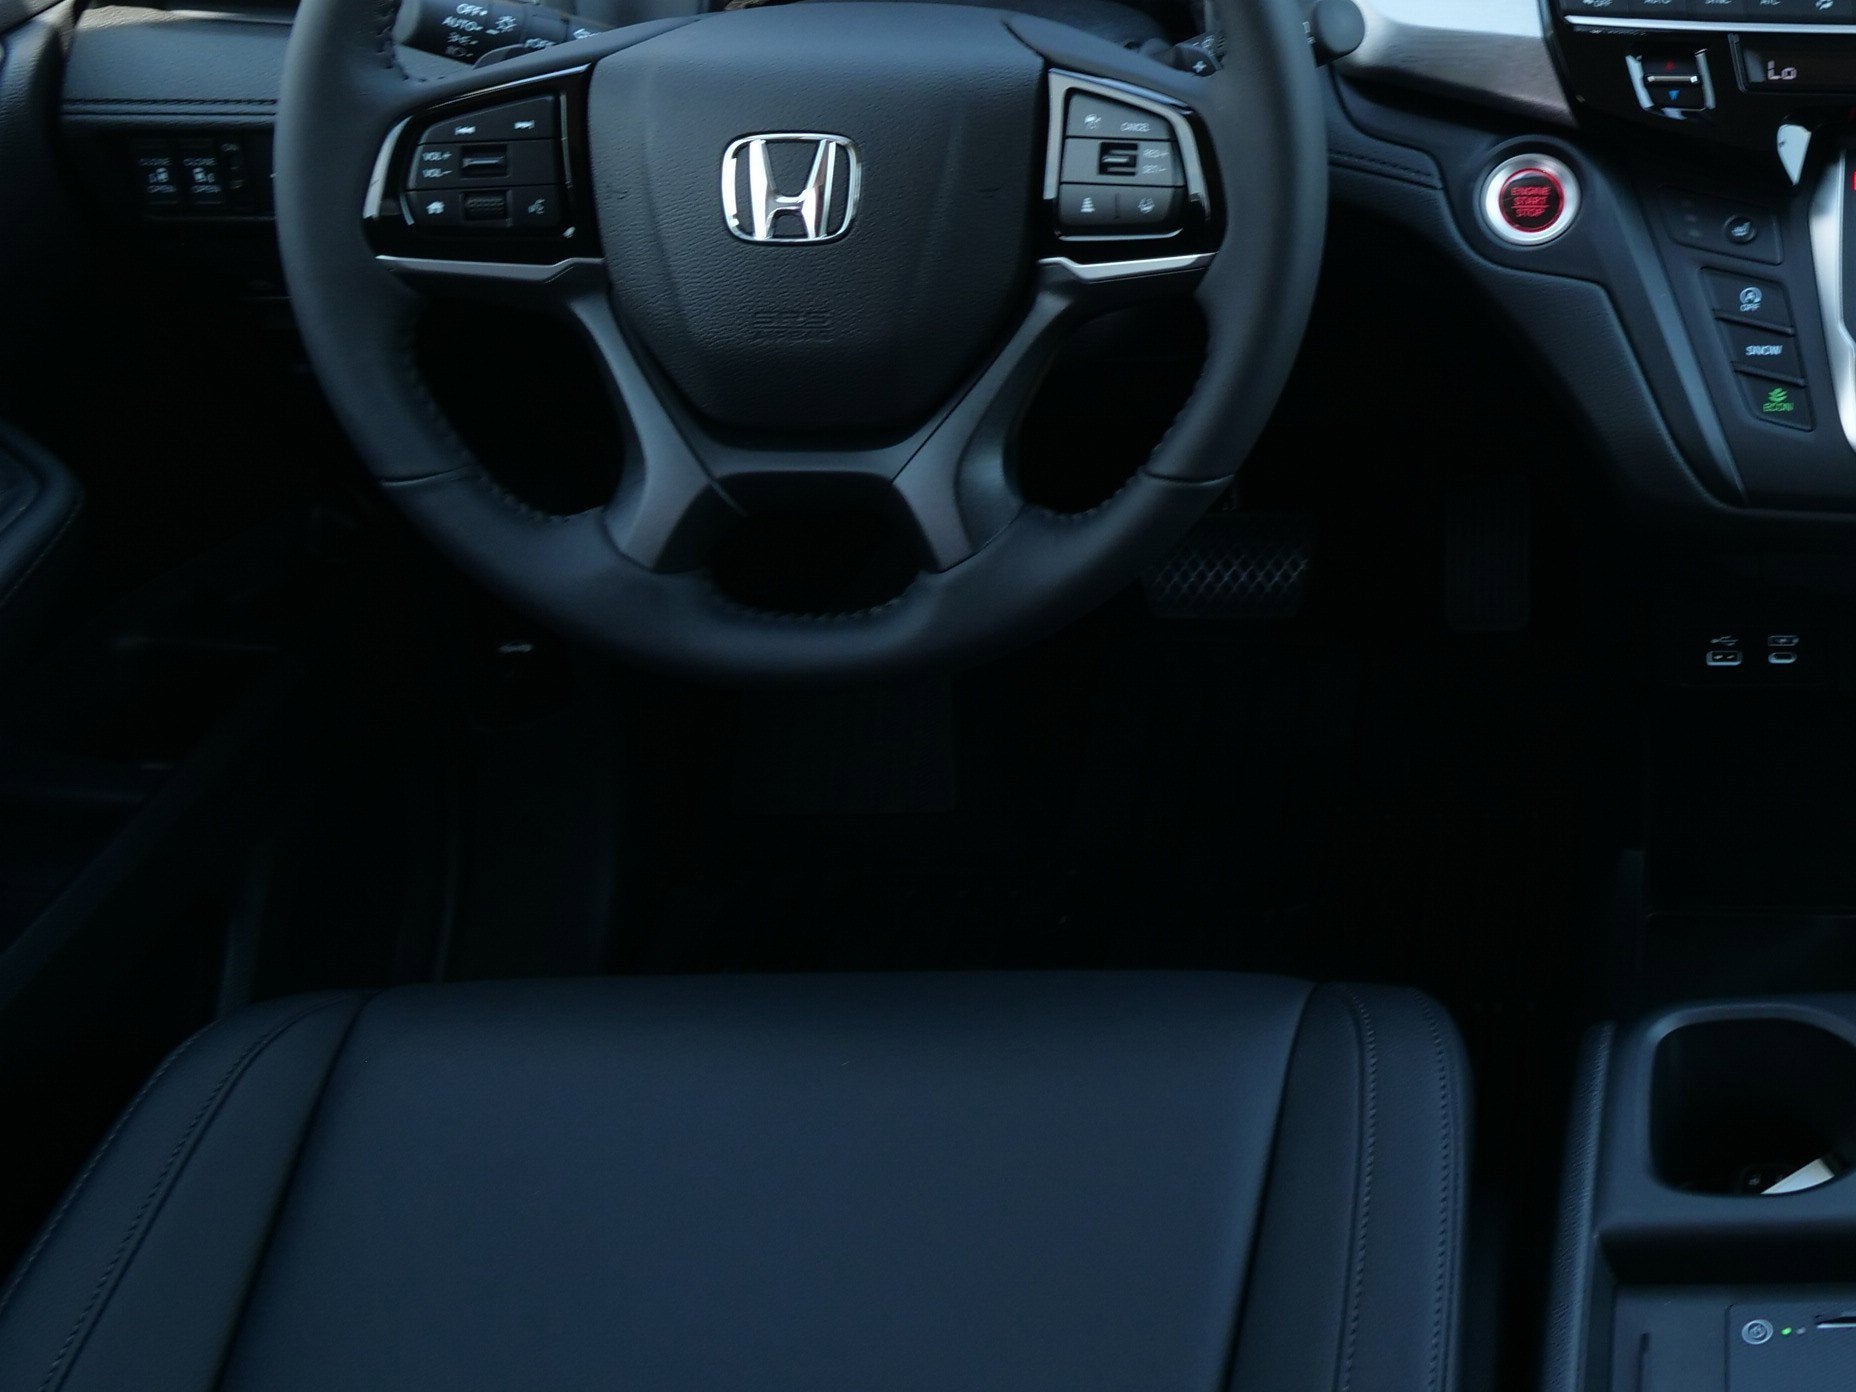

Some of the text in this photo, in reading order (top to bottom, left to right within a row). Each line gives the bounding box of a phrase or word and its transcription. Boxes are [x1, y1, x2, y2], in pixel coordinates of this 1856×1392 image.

[456, 3, 483, 16] OFF
[442, 16, 479, 31] AUTO
[1767, 60, 1798, 80] Lo
[1511, 187, 1550, 196] ENGINE
[1513, 196, 1549, 205] START
[1515, 207, 1546, 218] STOP
[1744, 344, 1784, 356] SNOW
[1762, 401, 1795, 412] ECON
